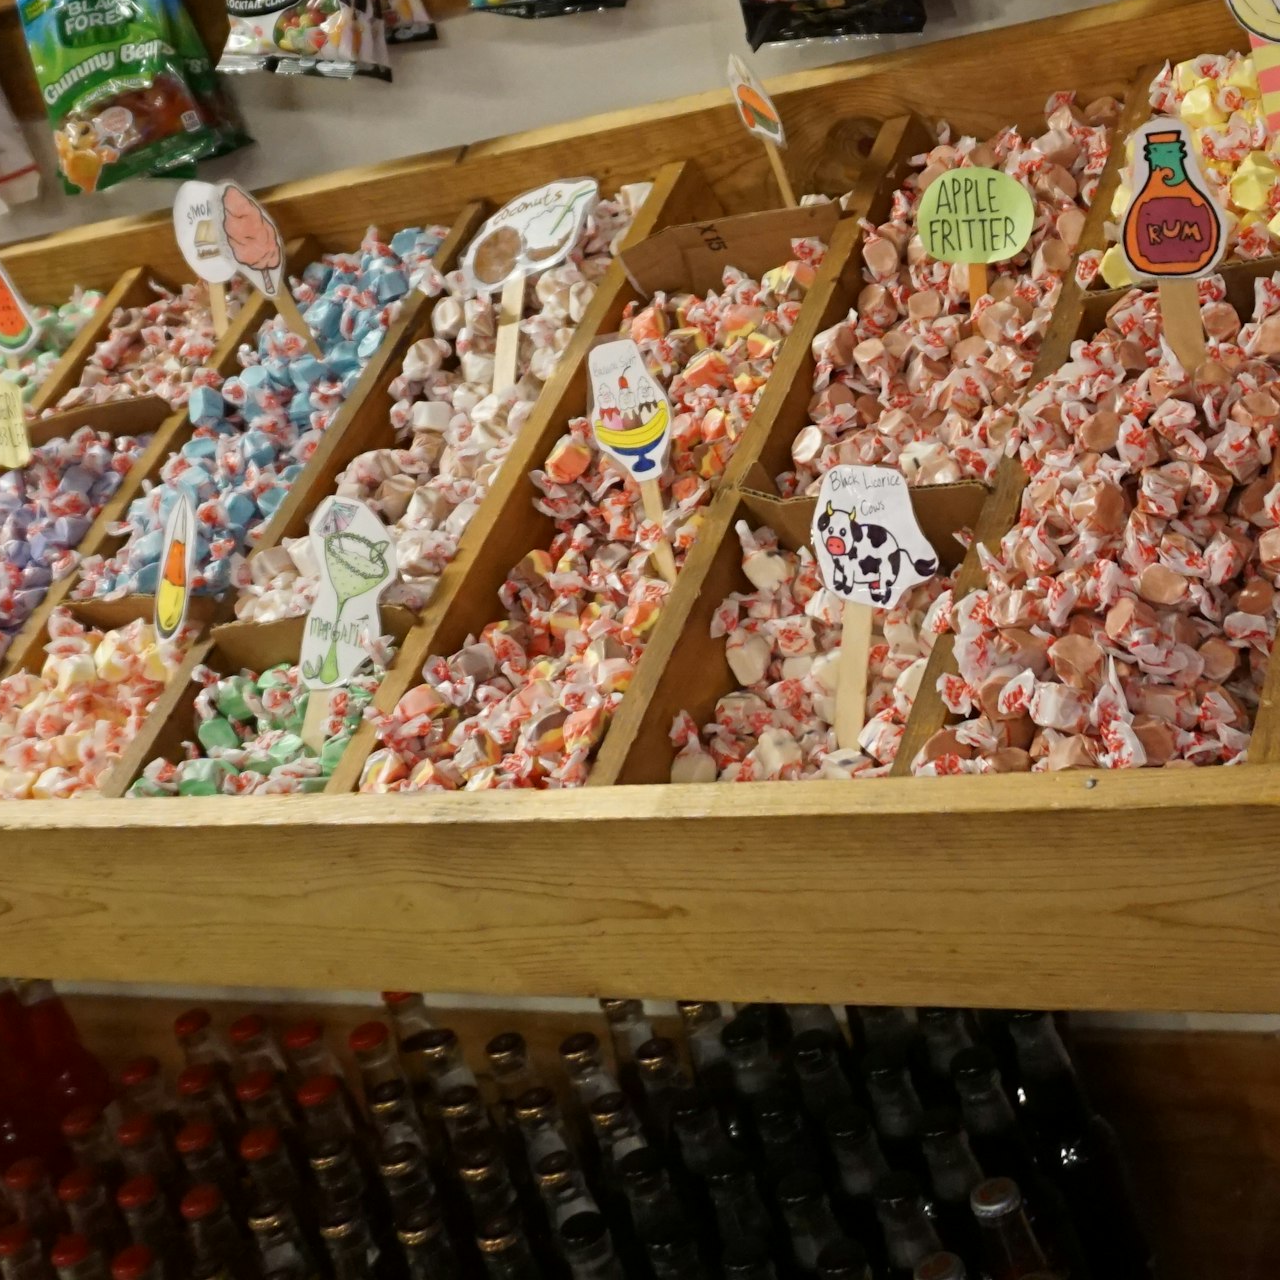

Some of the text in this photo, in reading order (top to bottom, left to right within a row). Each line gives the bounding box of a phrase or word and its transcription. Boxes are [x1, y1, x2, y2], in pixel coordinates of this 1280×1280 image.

[42, 49, 117, 106] Gummy
[492, 188, 563, 226] coconuts
[935, 177, 1001, 215] APPLE
[928, 215, 1018, 255] FRITTER
[1147, 220, 1203, 247] RUM
[828, 469, 861, 492] Black
[859, 499, 886, 517] Cows
